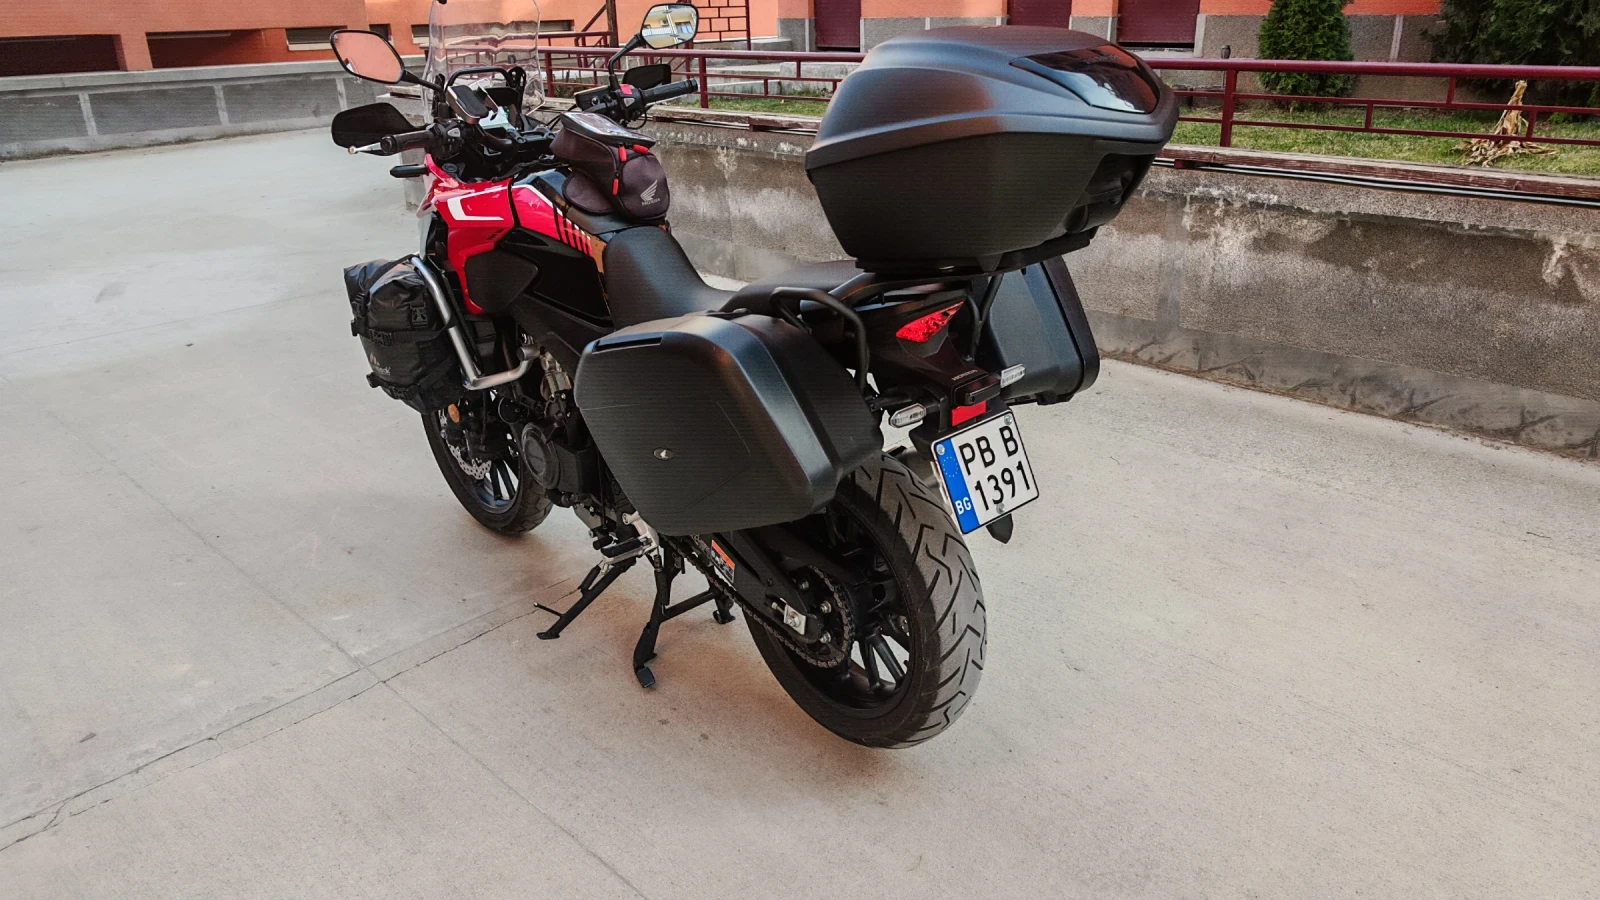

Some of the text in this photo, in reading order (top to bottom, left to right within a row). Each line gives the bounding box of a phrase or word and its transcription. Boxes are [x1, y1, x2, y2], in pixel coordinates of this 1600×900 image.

[958, 425, 1019, 476] PB B
[954, 496, 972, 515] BG
[974, 460, 1031, 511] 1391
